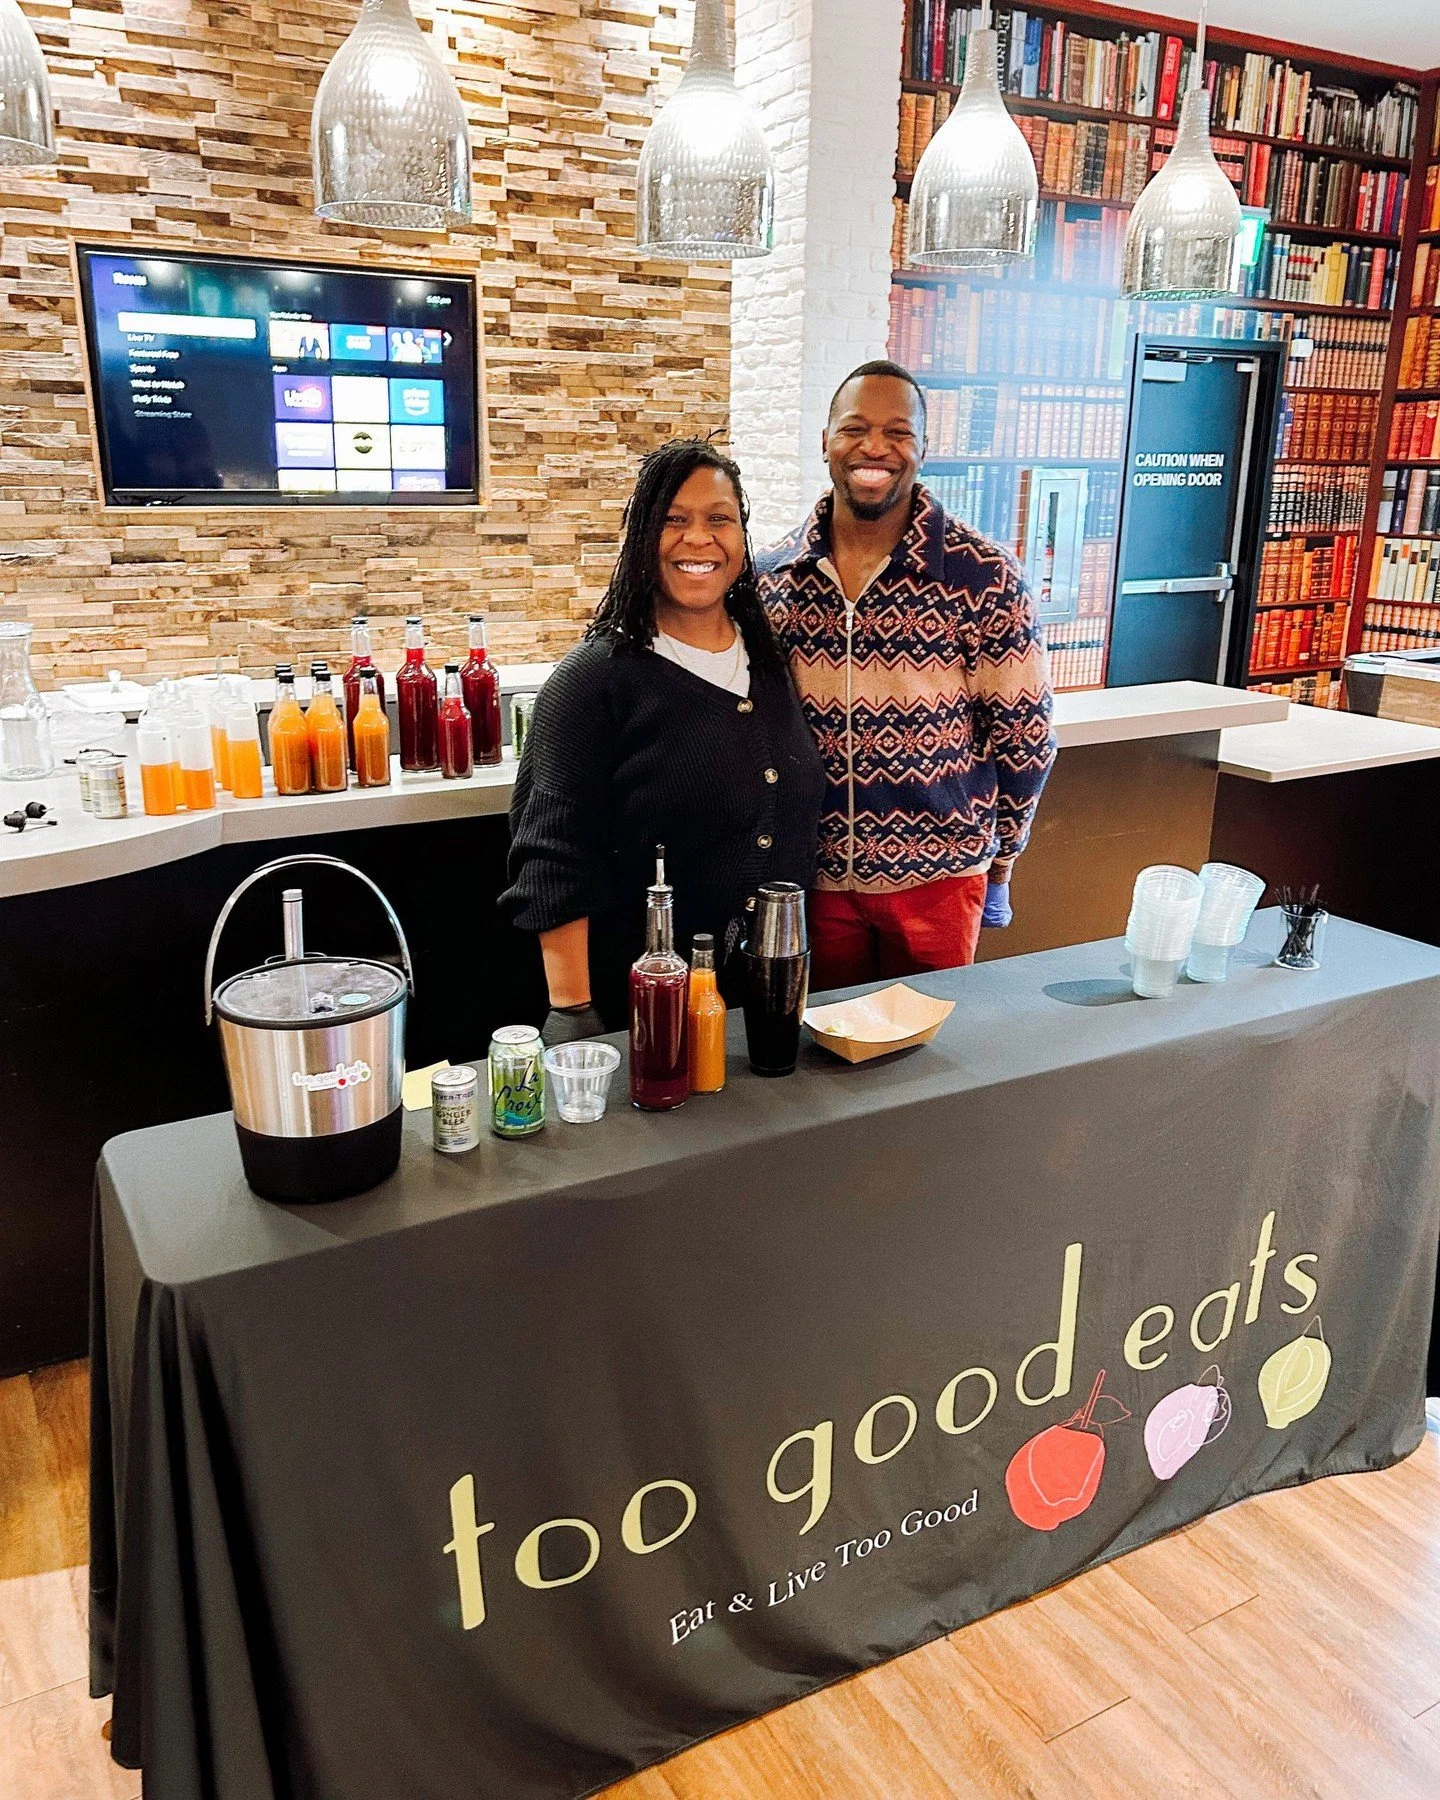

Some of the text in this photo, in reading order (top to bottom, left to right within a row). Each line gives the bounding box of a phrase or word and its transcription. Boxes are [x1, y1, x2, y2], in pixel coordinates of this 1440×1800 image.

[1135, 453, 1225, 467] CAUTION WHEN
[1133, 472, 1223, 487] OPENING DOOR
[516, 1060, 540, 1091] La
[436, 1109, 471, 1119] GINGER
[442, 1117, 465, 1126] BEER
[443, 1210, 1319, 1630] too good eats
[669, 1488, 979, 1645] Eat & Live Too Good
